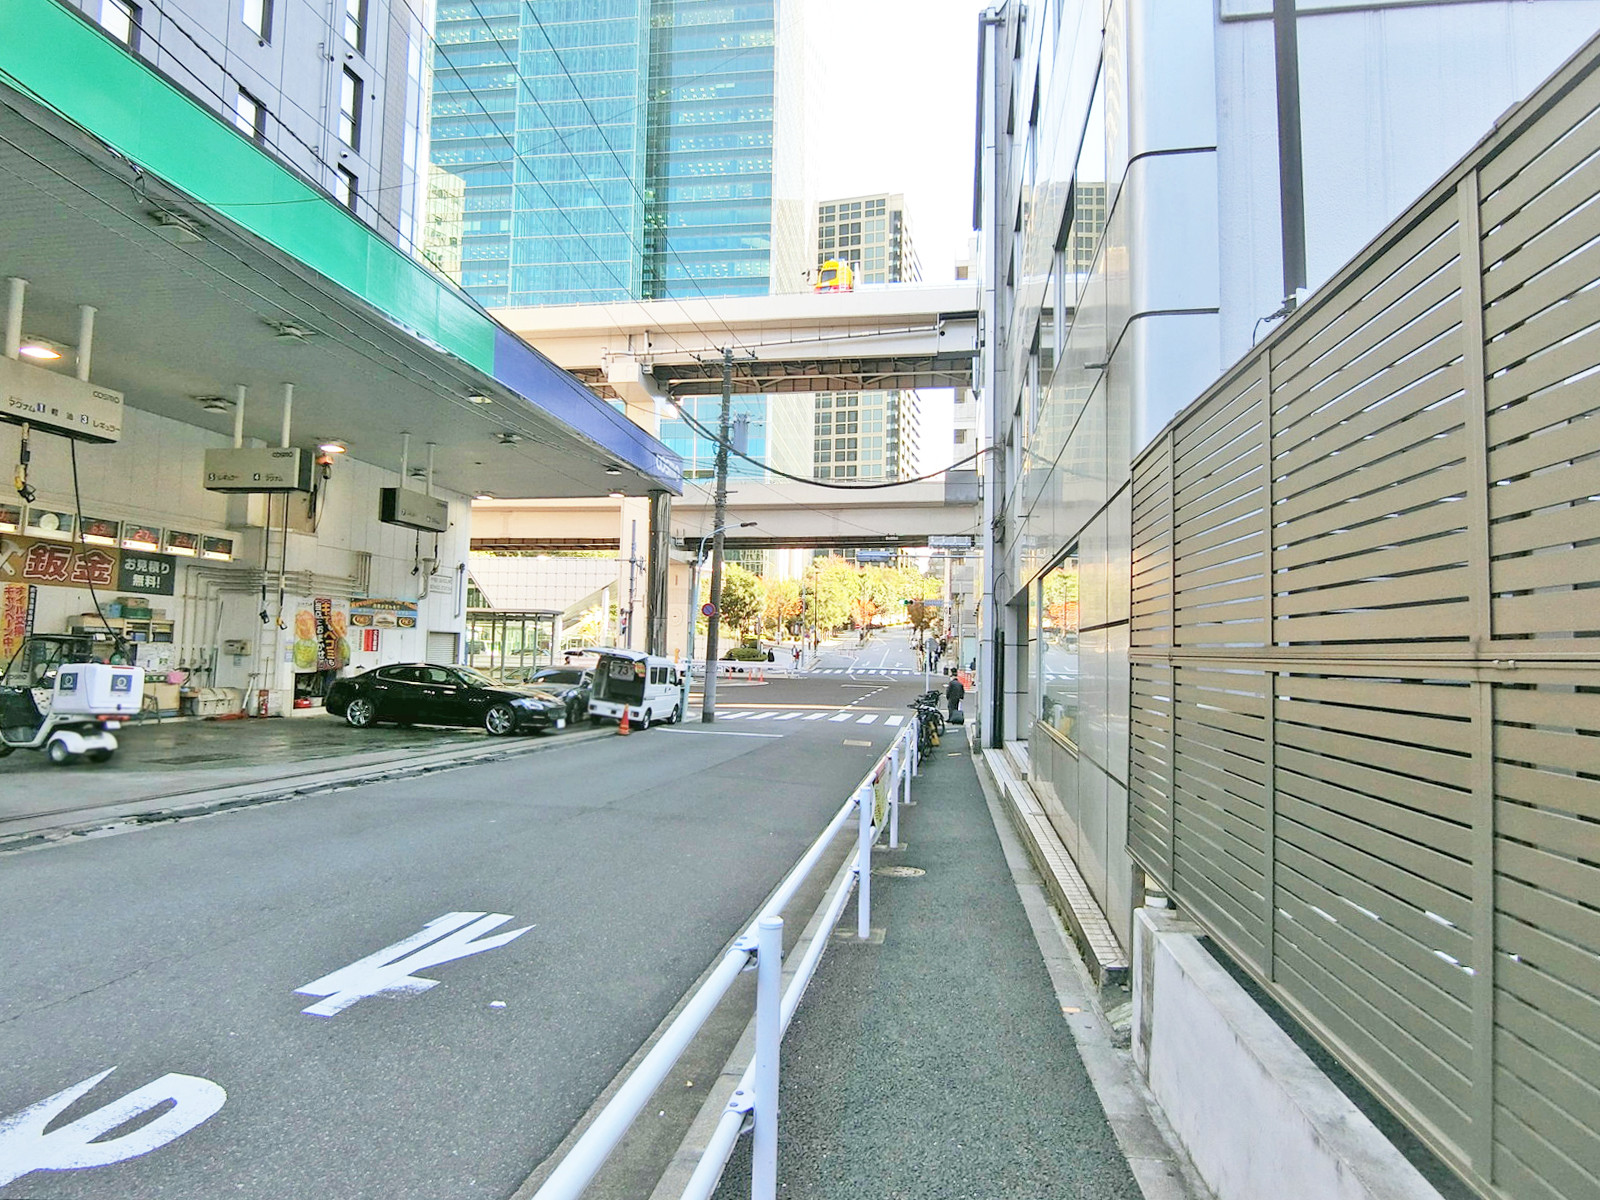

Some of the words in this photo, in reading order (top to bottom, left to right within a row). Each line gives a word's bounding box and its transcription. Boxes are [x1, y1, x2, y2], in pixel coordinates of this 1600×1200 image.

[80, 414, 89, 424] 3
[23, 542, 116, 585] 鈑金
[124, 557, 170, 574] お見積り
[132, 575, 161, 589] 無料!
